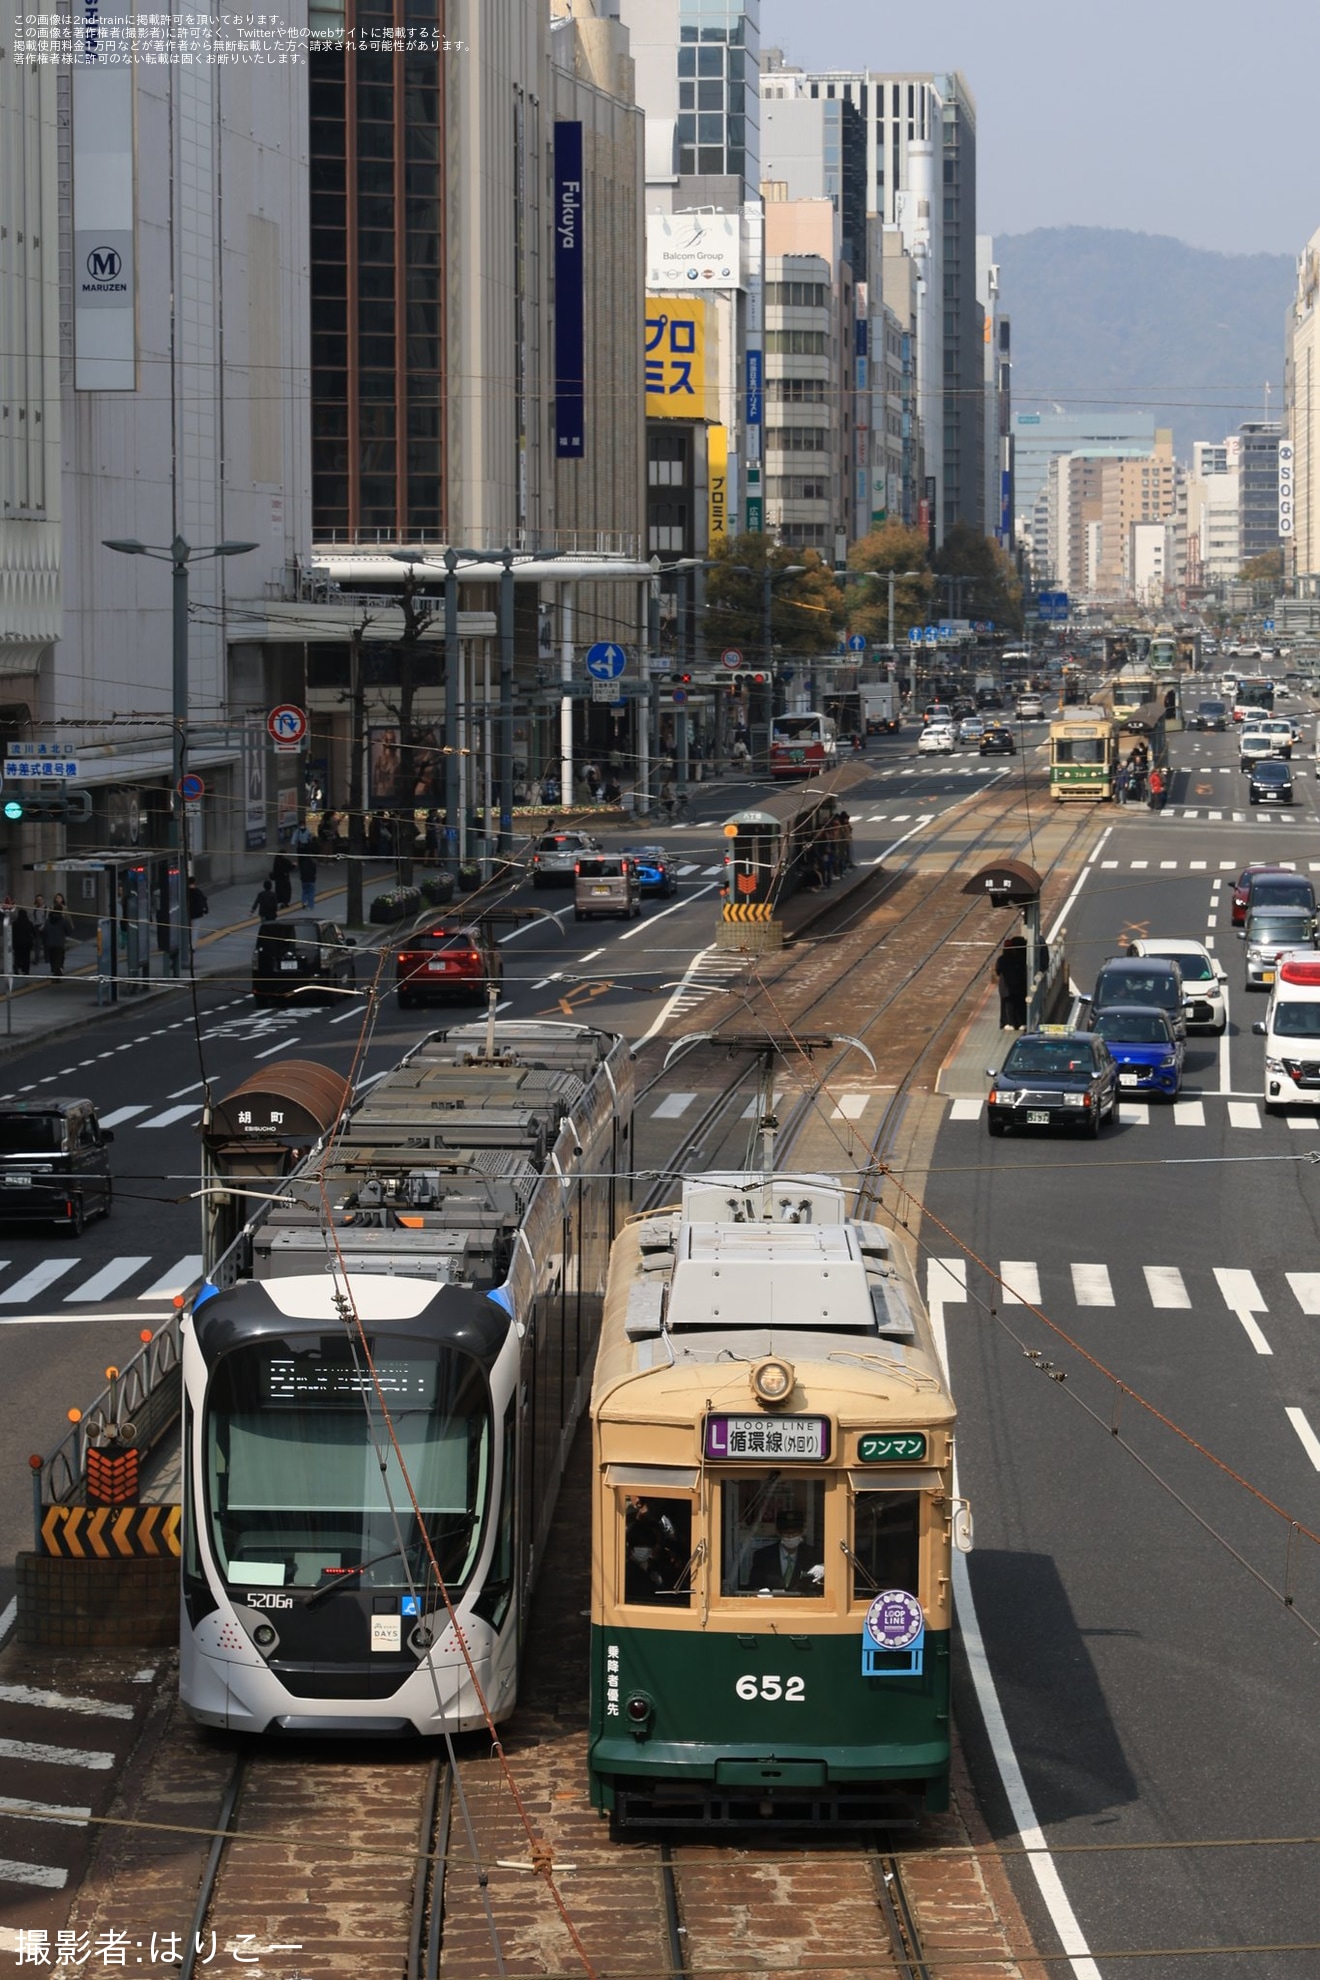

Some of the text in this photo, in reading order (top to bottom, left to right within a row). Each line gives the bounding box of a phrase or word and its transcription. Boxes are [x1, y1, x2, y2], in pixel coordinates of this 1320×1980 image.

[557, 181, 580, 248] Fukuya
[663, 252, 724, 262] Balcom Group
[82, 284, 127, 292] MARUZEN
[645, 314, 695, 353] プロ
[645, 360, 695, 394] ミス
[711, 476, 725, 531] プロミス
[1280, 467, 1291, 531] SOGO
[11, 744, 73, 754] 流川通北口
[6, 762, 77, 776] 時差式信号機
[238, 1111, 284, 1124] 胡町
[712, 1424, 726, 1449] L
[735, 1421, 814, 1431] LOOP LINE
[730, 1431, 819, 1453] 循環線(外回り)
[863, 1440, 922, 1455] ワンマン
[247, 1593, 293, 1609] 5206A
[607, 1645, 619, 1716] 乗降者優先
[735, 1674, 806, 1702] 652
